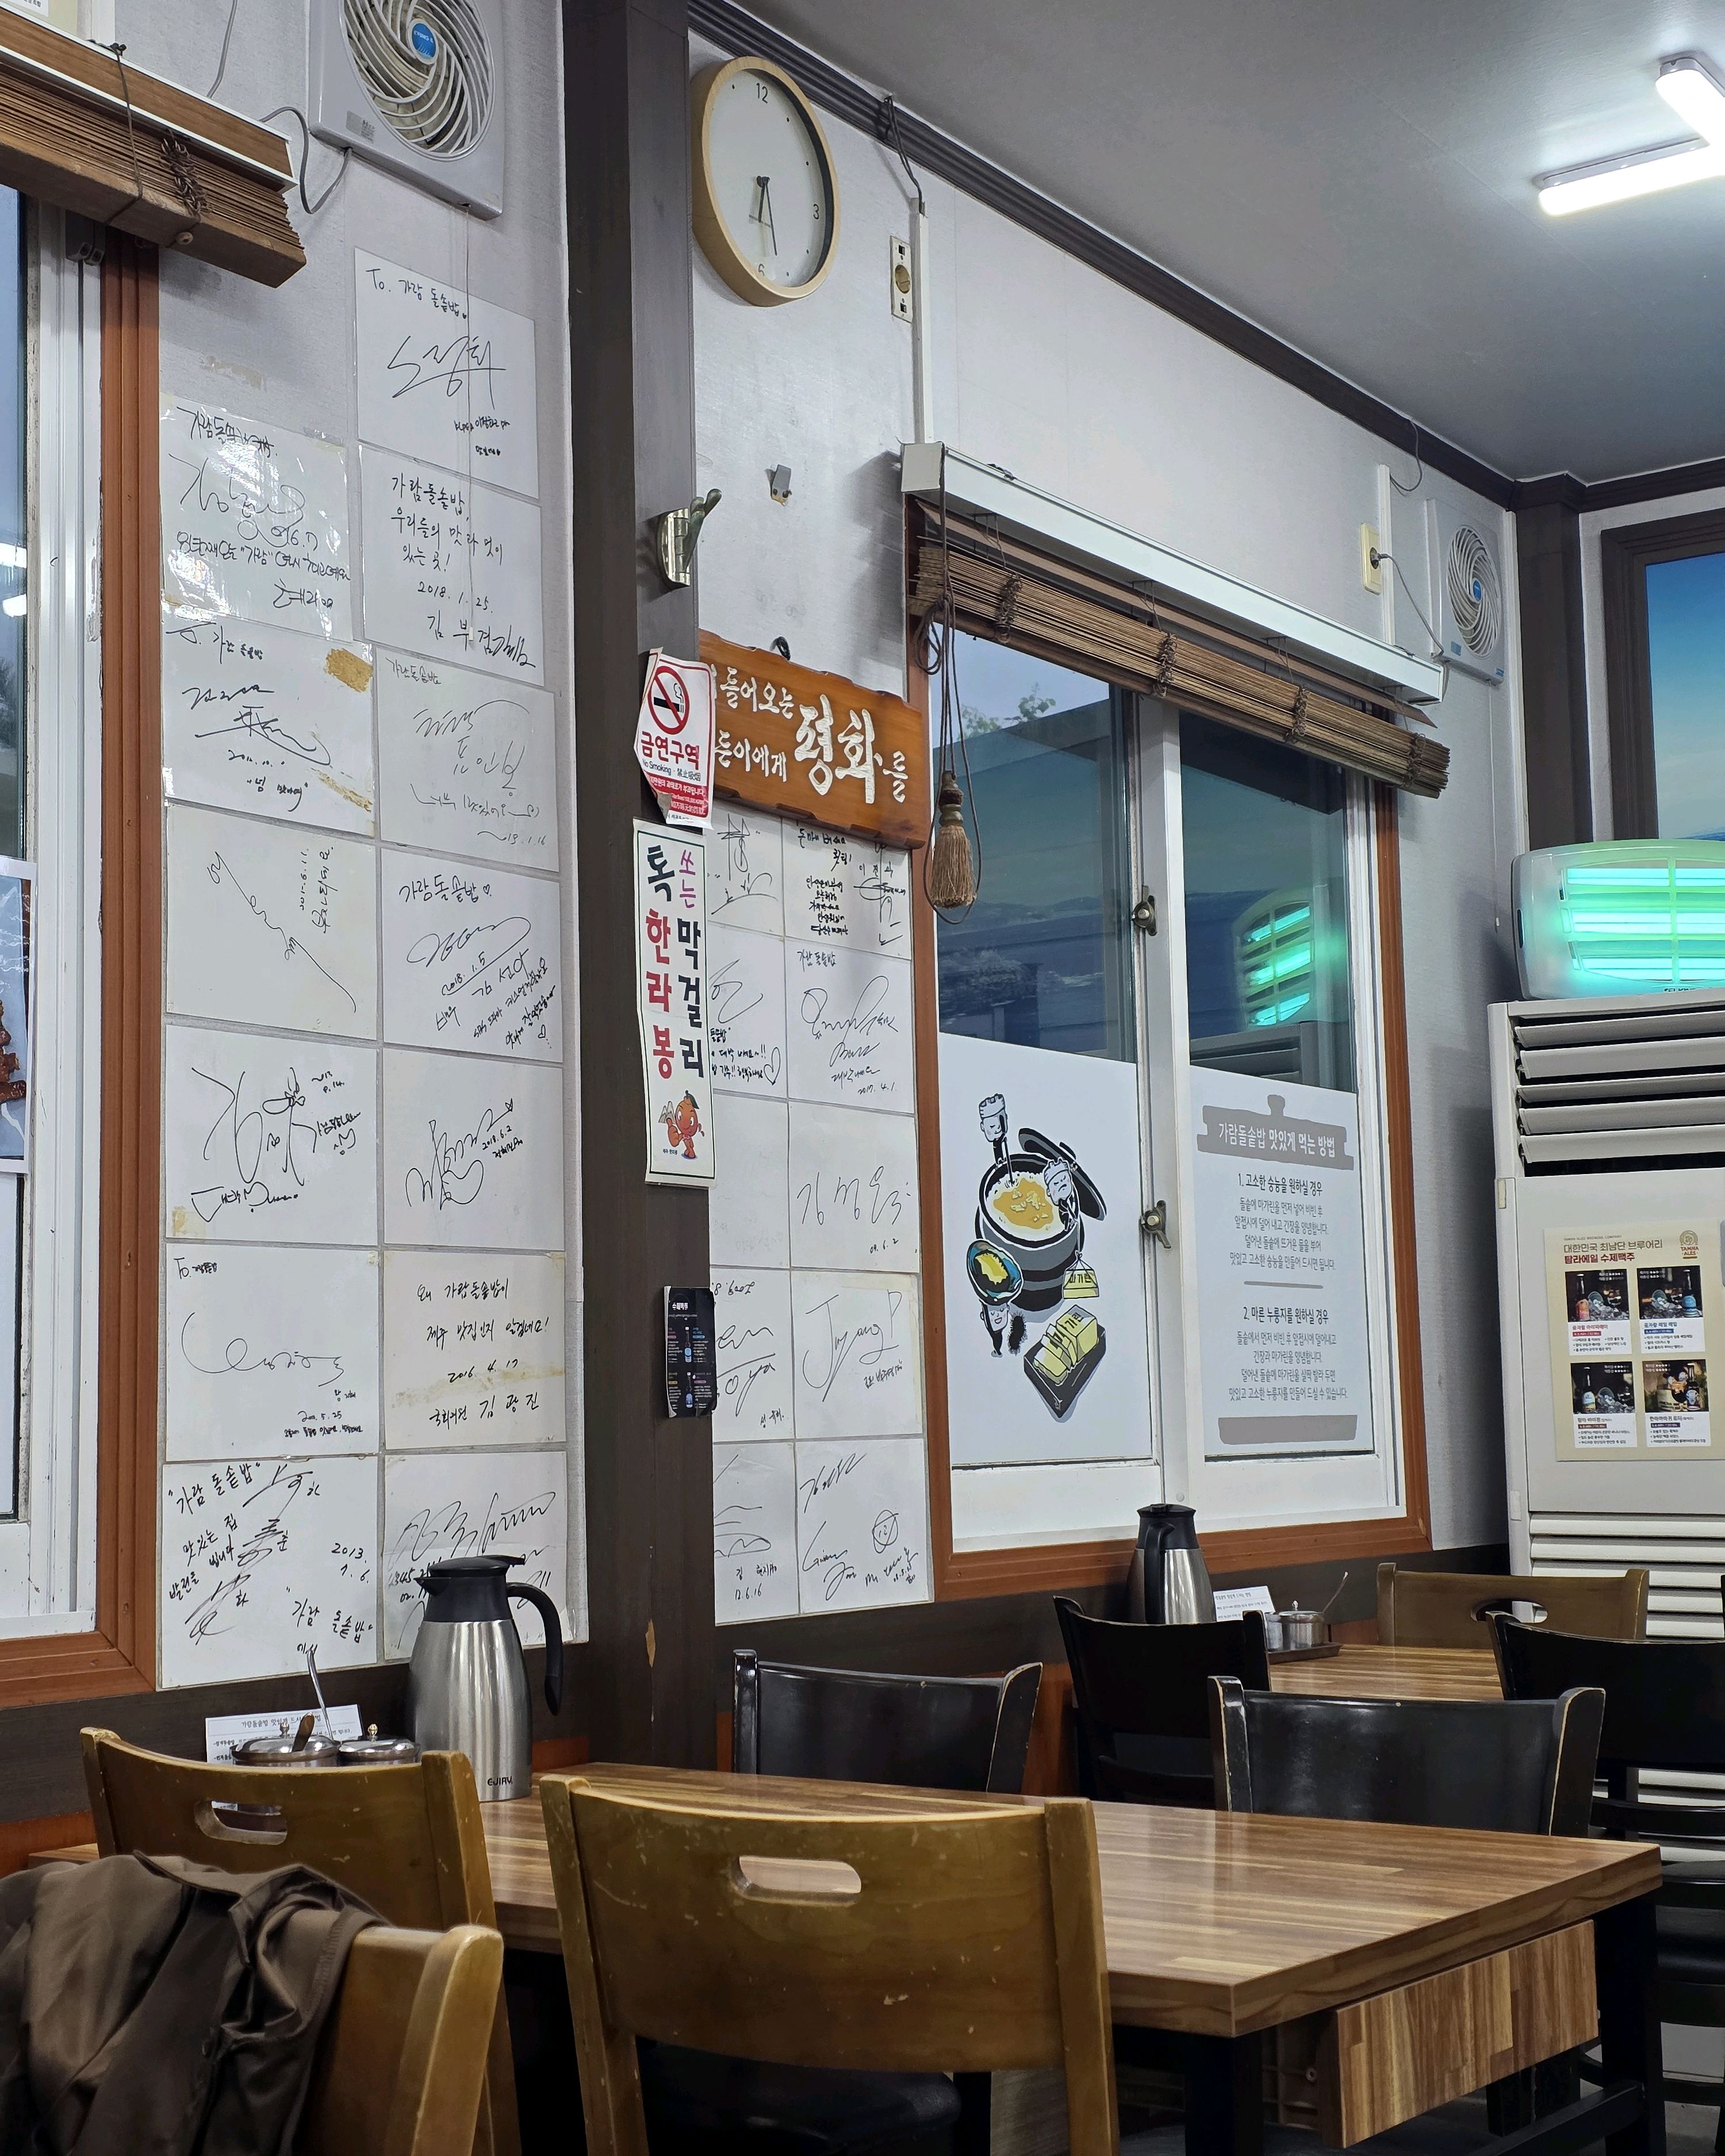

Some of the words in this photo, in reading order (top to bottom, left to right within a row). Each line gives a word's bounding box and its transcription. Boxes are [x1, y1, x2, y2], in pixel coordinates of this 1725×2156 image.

[756, 82, 768, 104] 12
[812, 203, 819, 220] 3
[366, 268, 391, 292] To.
[391, 507, 440, 550] 우리들의
[402, 543, 426, 566] 있는
[720, 666, 795, 720] 들어오는
[641, 730, 700, 770] 금연구역
[714, 730, 787, 783] 든이에게
[649, 761, 672, 776] Smoking
[647, 845, 676, 902] 톡
[679, 849, 696, 908] 쏘는
[645, 908, 676, 1079] 한라봉
[677, 917, 705, 1079] 막걸리
[1218, 1122, 1266, 1149] 가람돌솥밥
[1268, 1129, 1296, 1153] 맛있게
[1298, 1133, 1316, 1156] 먹는
[1318, 1137, 1336, 1158] 방법
[1238, 1173, 1244, 1187] 1.
[1245, 1173, 1266, 1191] 고소한
[1267, 1176, 1287, 1194] 숭늉을
[1289, 1178, 1309, 1196] 원하실
[1310, 1181, 1323, 1197] 경우
[1240, 1196, 1257, 1212] 돌솥에
[1258, 1198, 1281, 1215] 마가린을
[1283, 1220, 1300, 1234] 간장을
[1263, 1236, 1280, 1250] 돌솥에
[1563, 1243, 1598, 1253] 대한민국
[1599, 1241, 1626, 1252] 최남단
[1627, 1239, 1663, 1250] 브루어리
[1229, 1252, 1248, 1265] 맛있고
[1248, 1253, 1266, 1268] 고소한
[1564, 1253, 1598, 1264] 탐라에일
[1600, 1252, 1636, 1263] 수제맥주
[1243, 1306, 1250, 1321] 2.
[1251, 1306, 1266, 1323] 마른
[1266, 1306, 1294, 1324] 누룽지를
[1294, 1307, 1315, 1325] 원하실
[1316, 1309, 1329, 1325] 경우
[1237, 1330, 1260, 1345] 돌솥에서
[1271, 1350, 1294, 1364] 마가린을
[1228, 1387, 1247, 1402] 맛있고
[1248, 1387, 1266, 1401] 고소한
[1266, 1387, 1289, 1401] 누룽지를
[1319, 1387, 1325, 1399] 수
[479, 1394, 496, 1420] 김
[331, 1542, 367, 1564] 2013.
